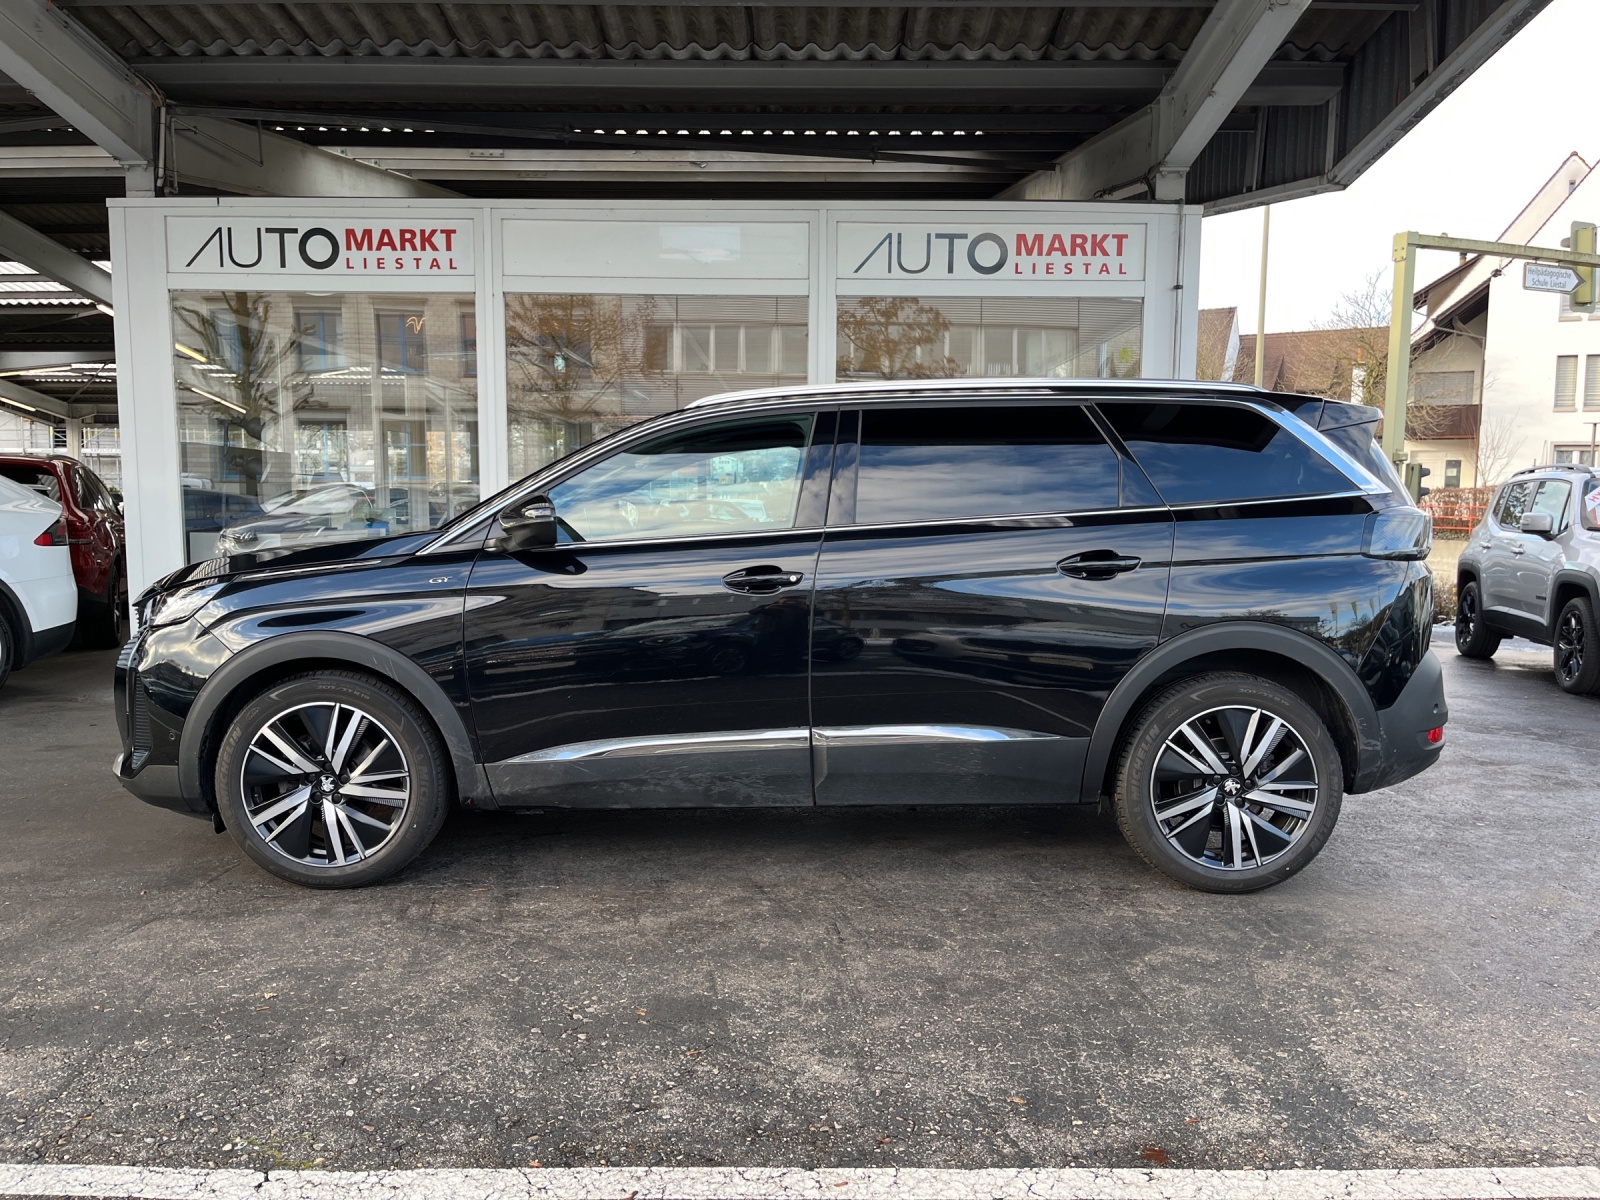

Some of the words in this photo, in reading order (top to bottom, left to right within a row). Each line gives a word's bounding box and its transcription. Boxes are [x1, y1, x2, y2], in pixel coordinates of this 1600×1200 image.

[185, 227, 340, 270] AUTO
[345, 228, 457, 252] MARKT
[852, 232, 1009, 275] AUTO
[1015, 233, 1129, 257] MARKT
[345, 257, 457, 270] LIESTAL
[1014, 262, 1127, 275] LIESTAL
[1528, 267, 1572, 280] Heilpädagogische
[1532, 278, 1548, 287] Schule
[1550, 280, 1566, 289] Liestal
[428, 575, 453, 584] GT
[220, 726, 243, 805] MICHELIN
[1130, 723, 1161, 802] MICHELIN
